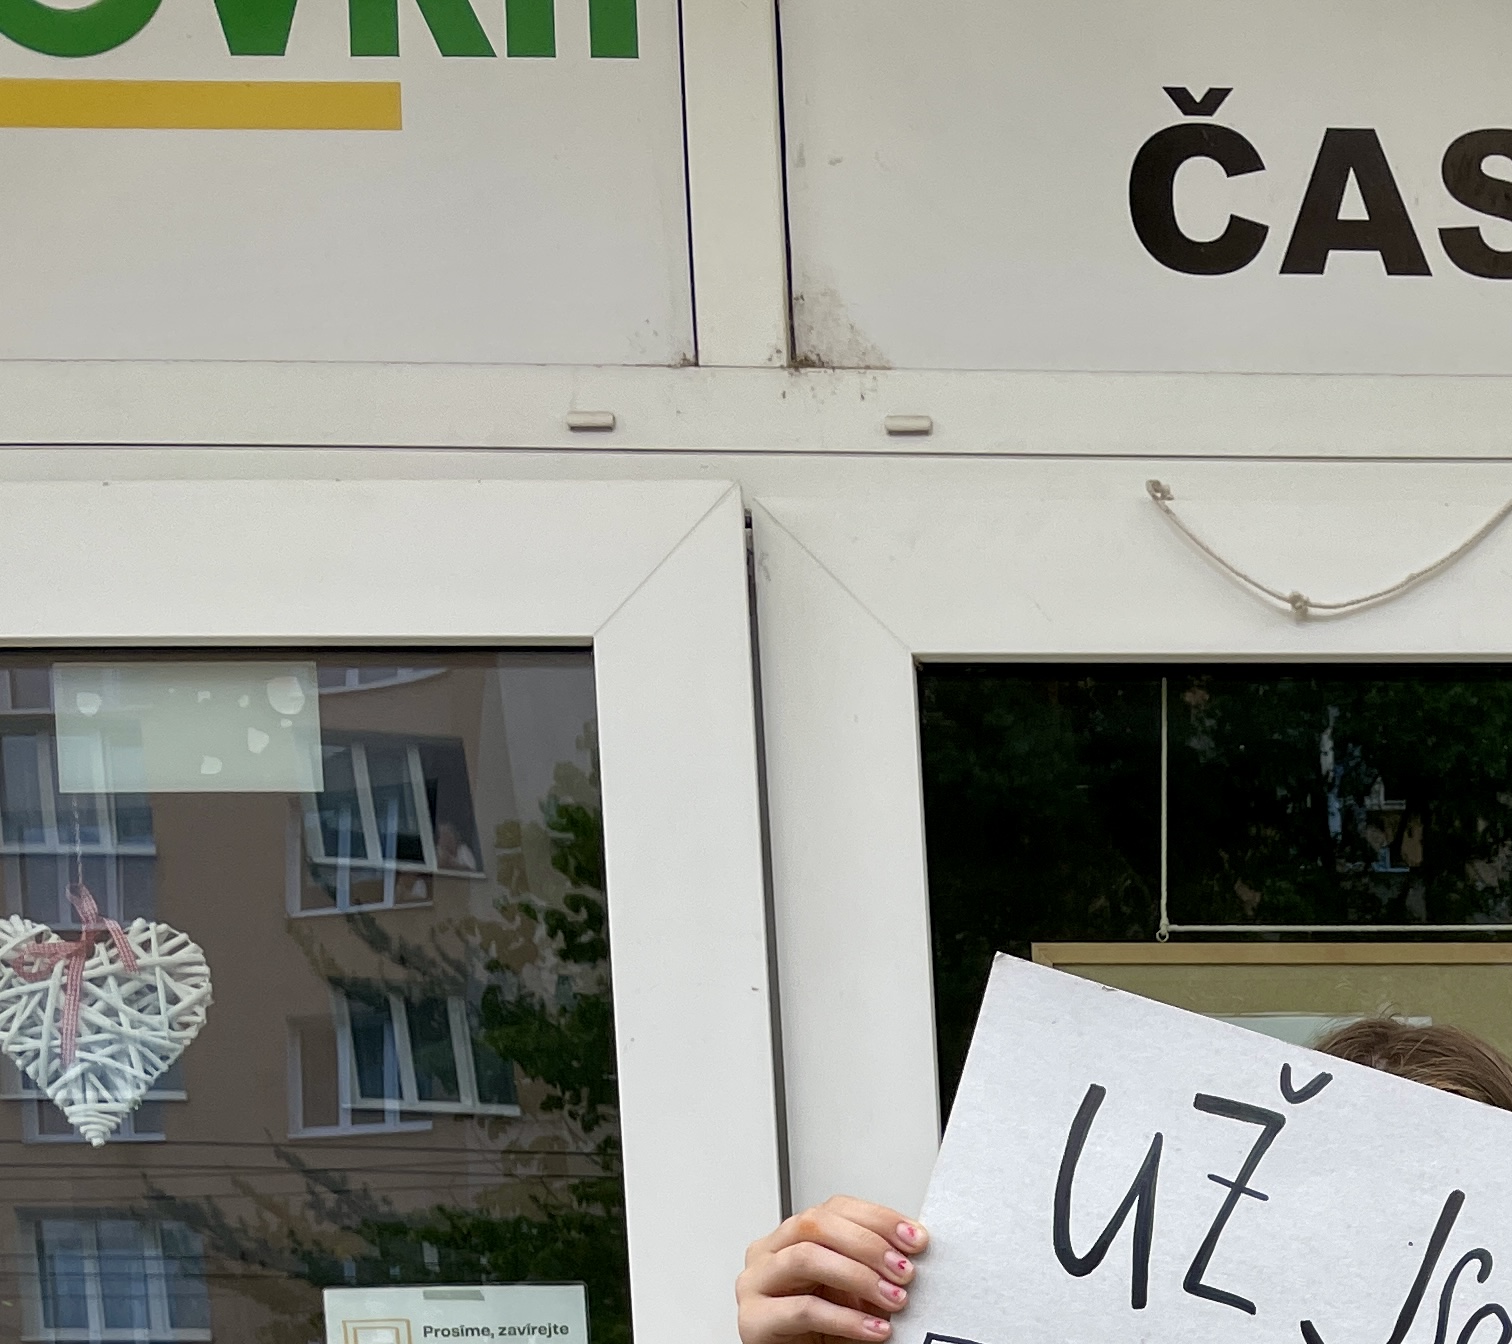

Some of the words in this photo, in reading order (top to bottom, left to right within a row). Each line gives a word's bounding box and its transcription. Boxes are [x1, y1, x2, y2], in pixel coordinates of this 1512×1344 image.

[1052, 1062, 1333, 1317] UŽ
[422, 1324, 495, 1339] Prosíme,
[497, 1322, 570, 1340] zavírejte
